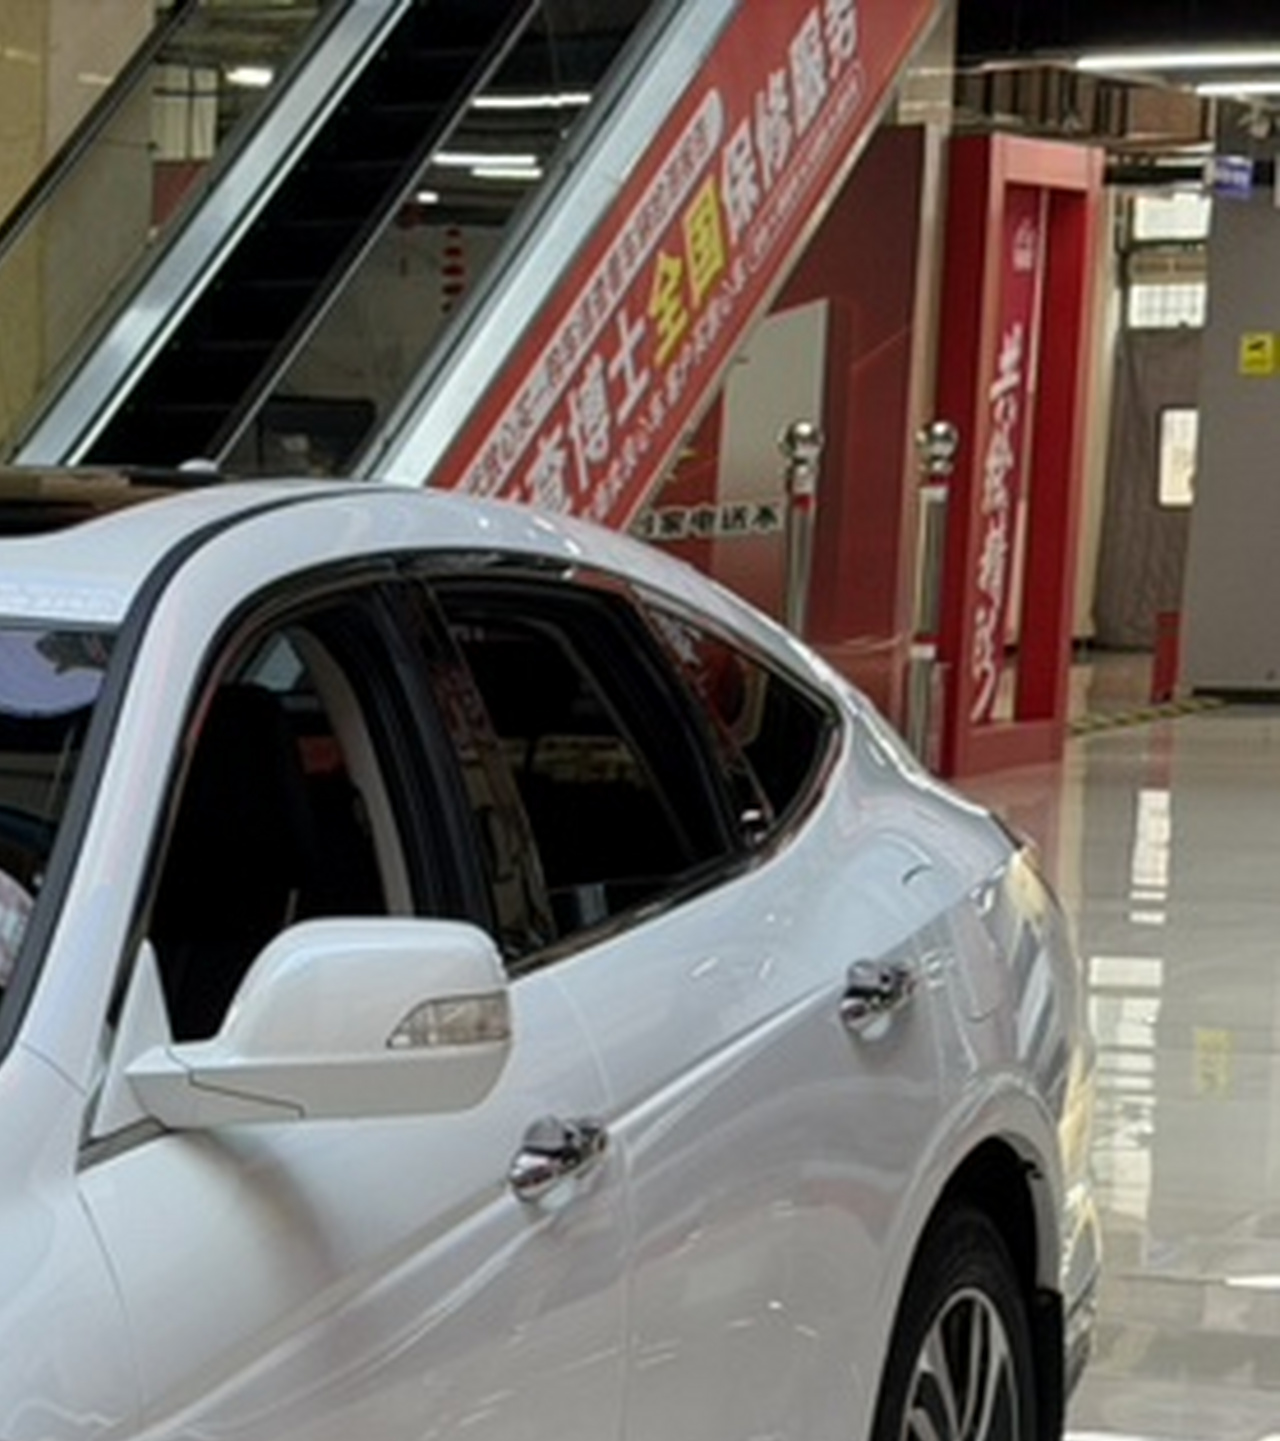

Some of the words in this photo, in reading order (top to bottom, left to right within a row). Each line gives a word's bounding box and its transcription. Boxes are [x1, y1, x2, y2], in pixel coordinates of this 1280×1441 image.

[510, 0, 858, 516] 查博士全国保修服务
